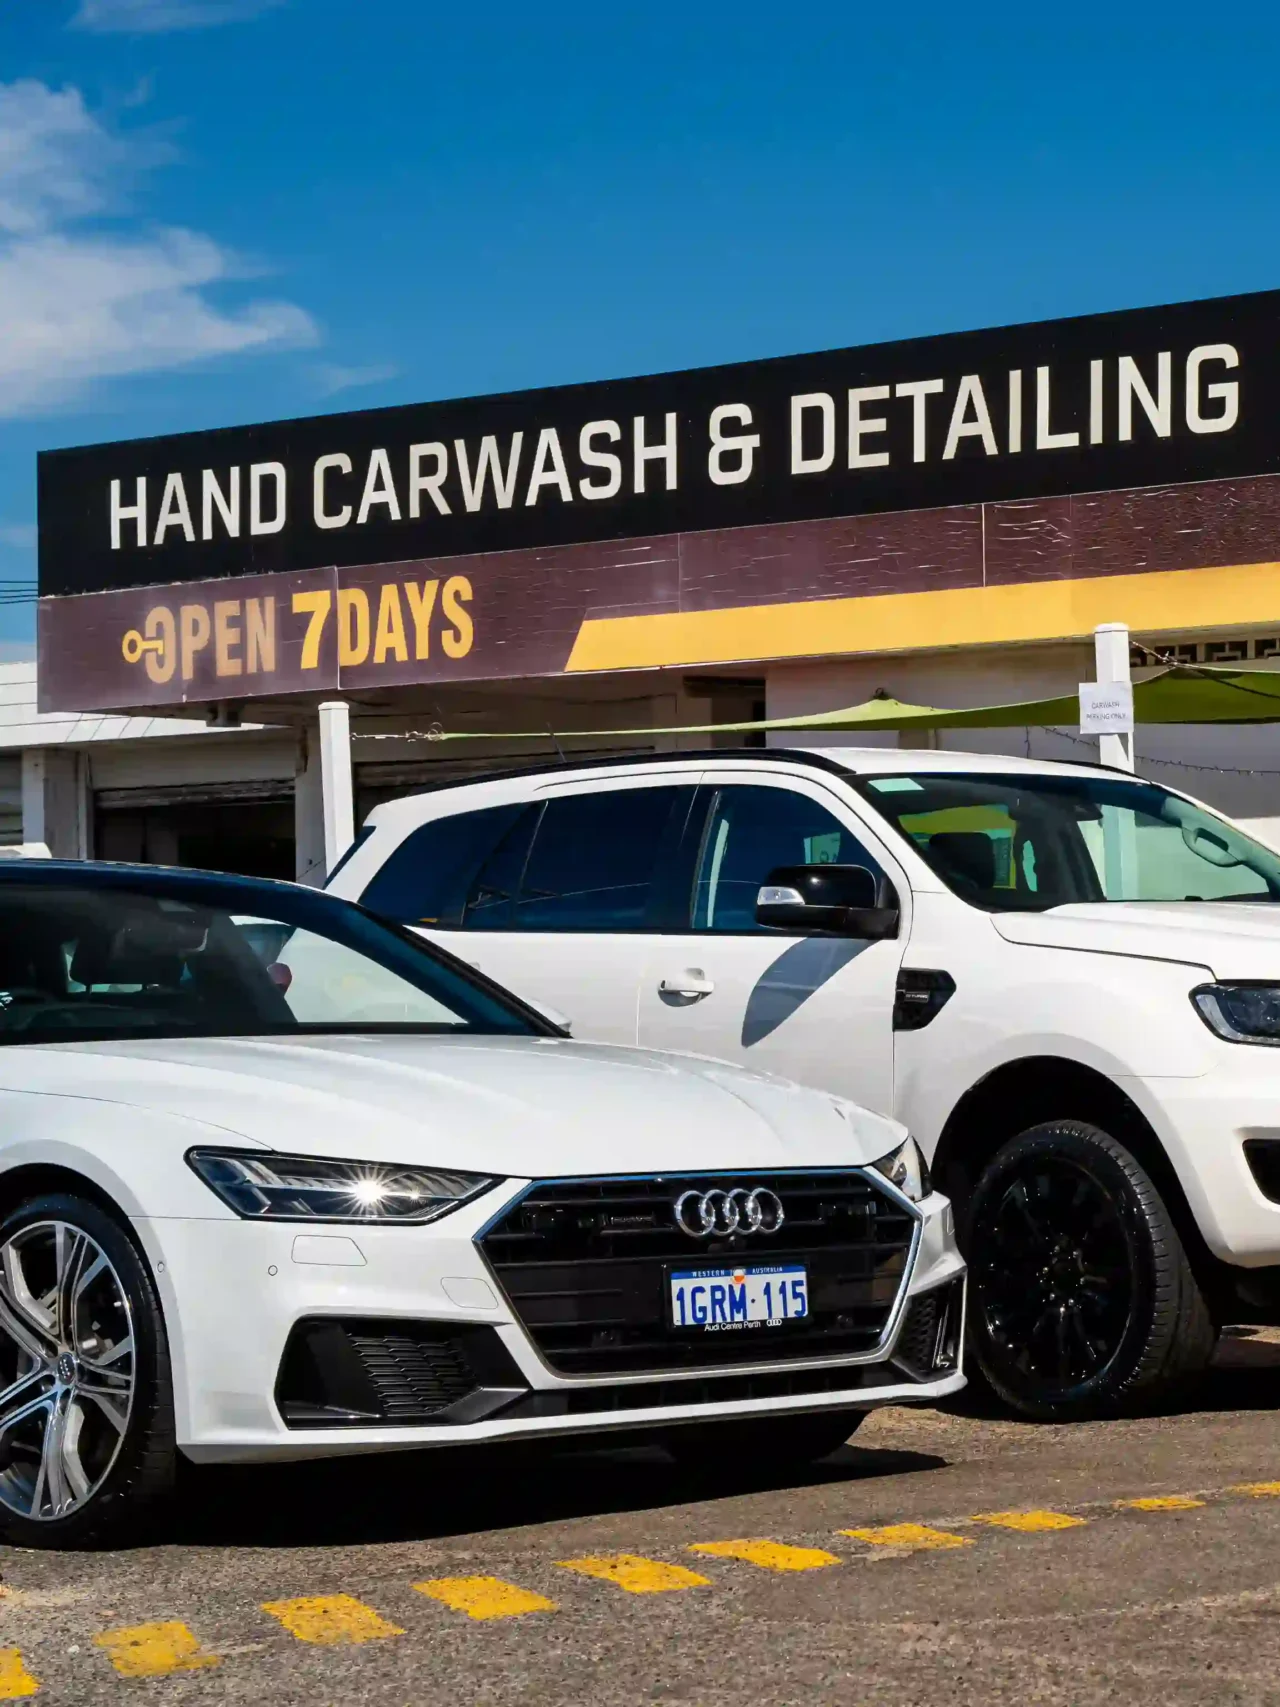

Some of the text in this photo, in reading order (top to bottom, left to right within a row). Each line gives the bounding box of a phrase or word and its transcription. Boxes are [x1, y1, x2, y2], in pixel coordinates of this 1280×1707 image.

[110, 343, 1240, 550] HAND CARWASH & DETAILING
[145, 596, 276, 684] OPEN
[692, 1266, 783, 1277] WESTERN AUSTRALIA
[704, 1320, 761, 1332] Audi Centre Perth
